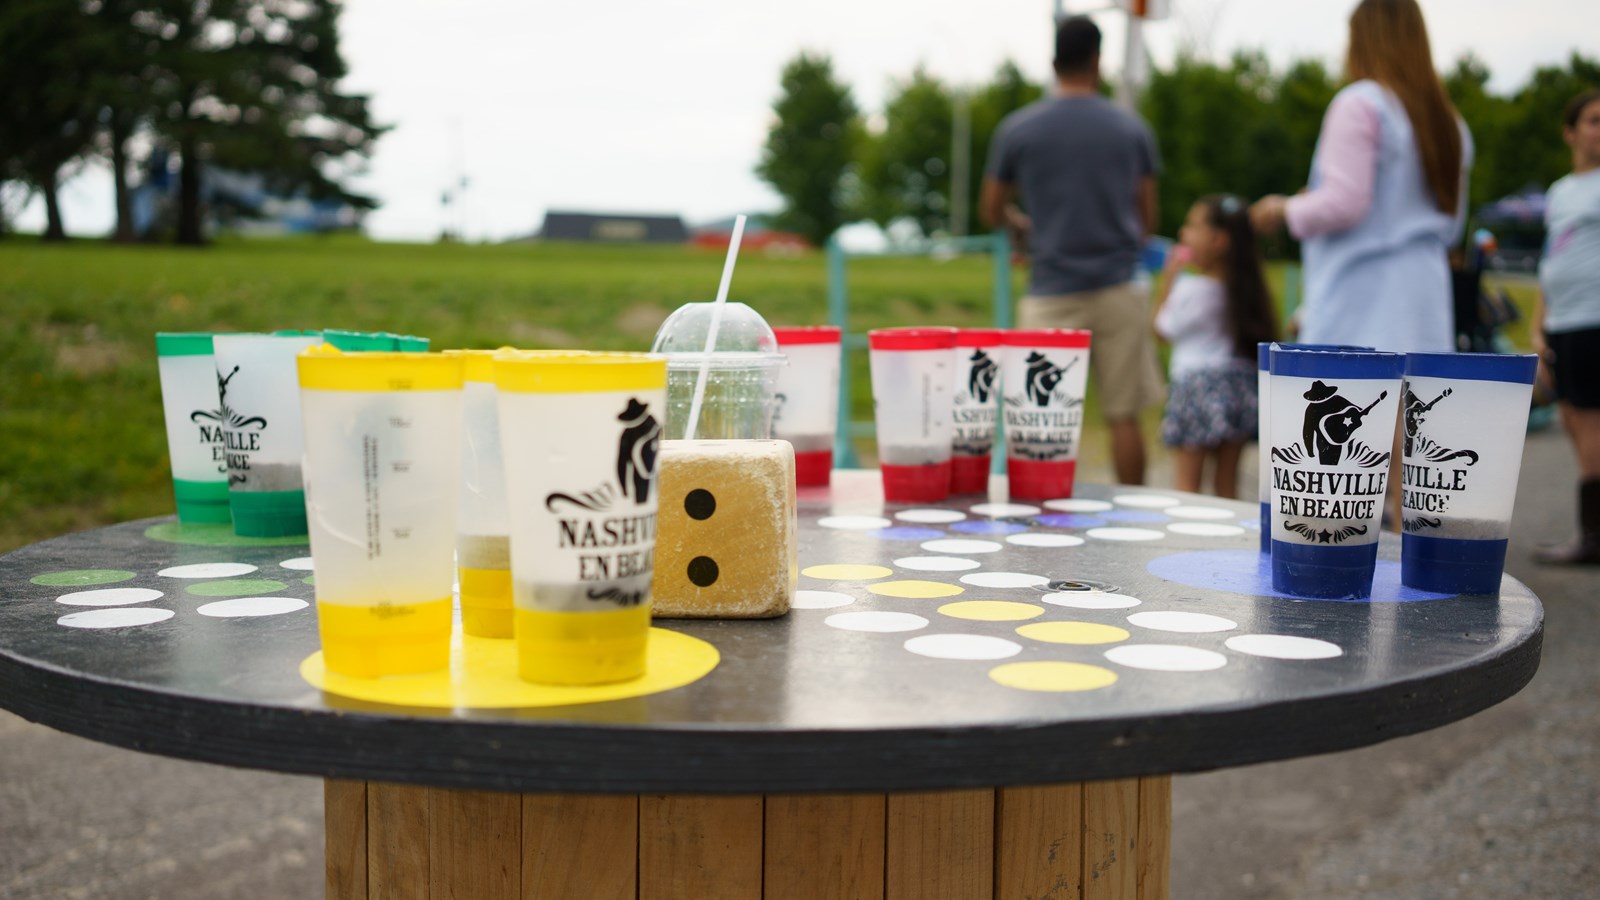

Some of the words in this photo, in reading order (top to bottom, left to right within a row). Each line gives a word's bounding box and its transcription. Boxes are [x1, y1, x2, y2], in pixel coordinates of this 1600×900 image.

[226, 453, 251, 470] UCE
[1273, 467, 1386, 495] NASHVILLE
[1402, 463, 1467, 491] VILLE
[1280, 495, 1300, 516] EN
[1302, 498, 1375, 520] BEAUCE
[1402, 489, 1450, 513] EAUCE
[579, 555, 610, 581] EN
[617, 548, 654, 579] BEA
